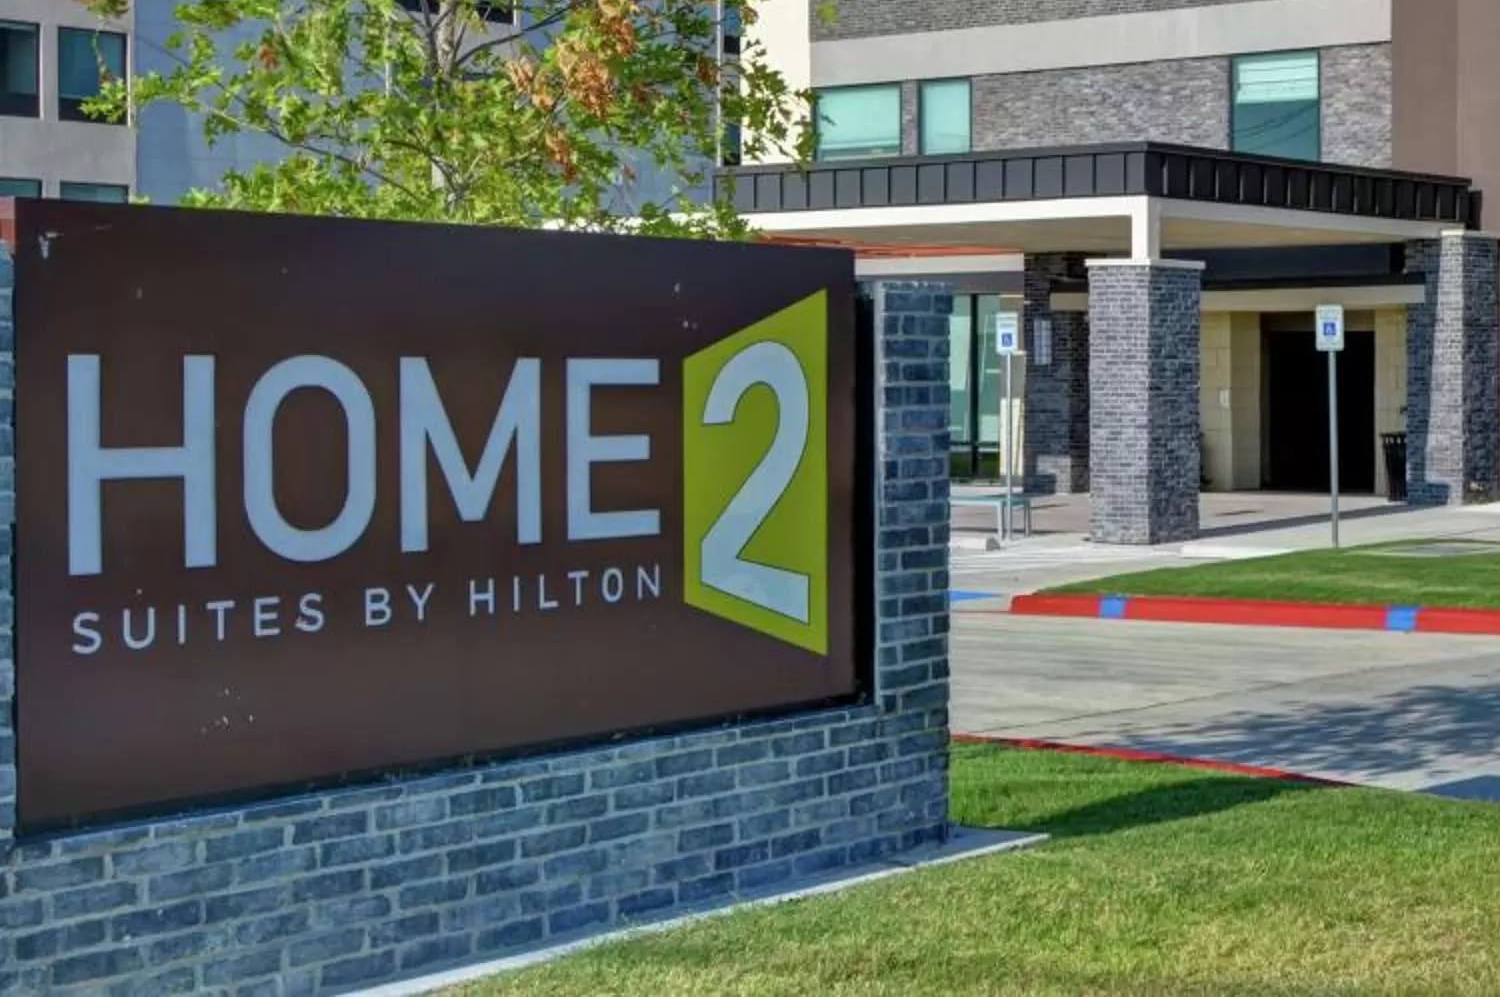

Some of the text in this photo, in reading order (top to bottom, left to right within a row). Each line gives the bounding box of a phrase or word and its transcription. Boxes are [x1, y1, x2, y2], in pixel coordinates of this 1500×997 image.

[71, 563, 662, 655] SUITES BY HILTON
